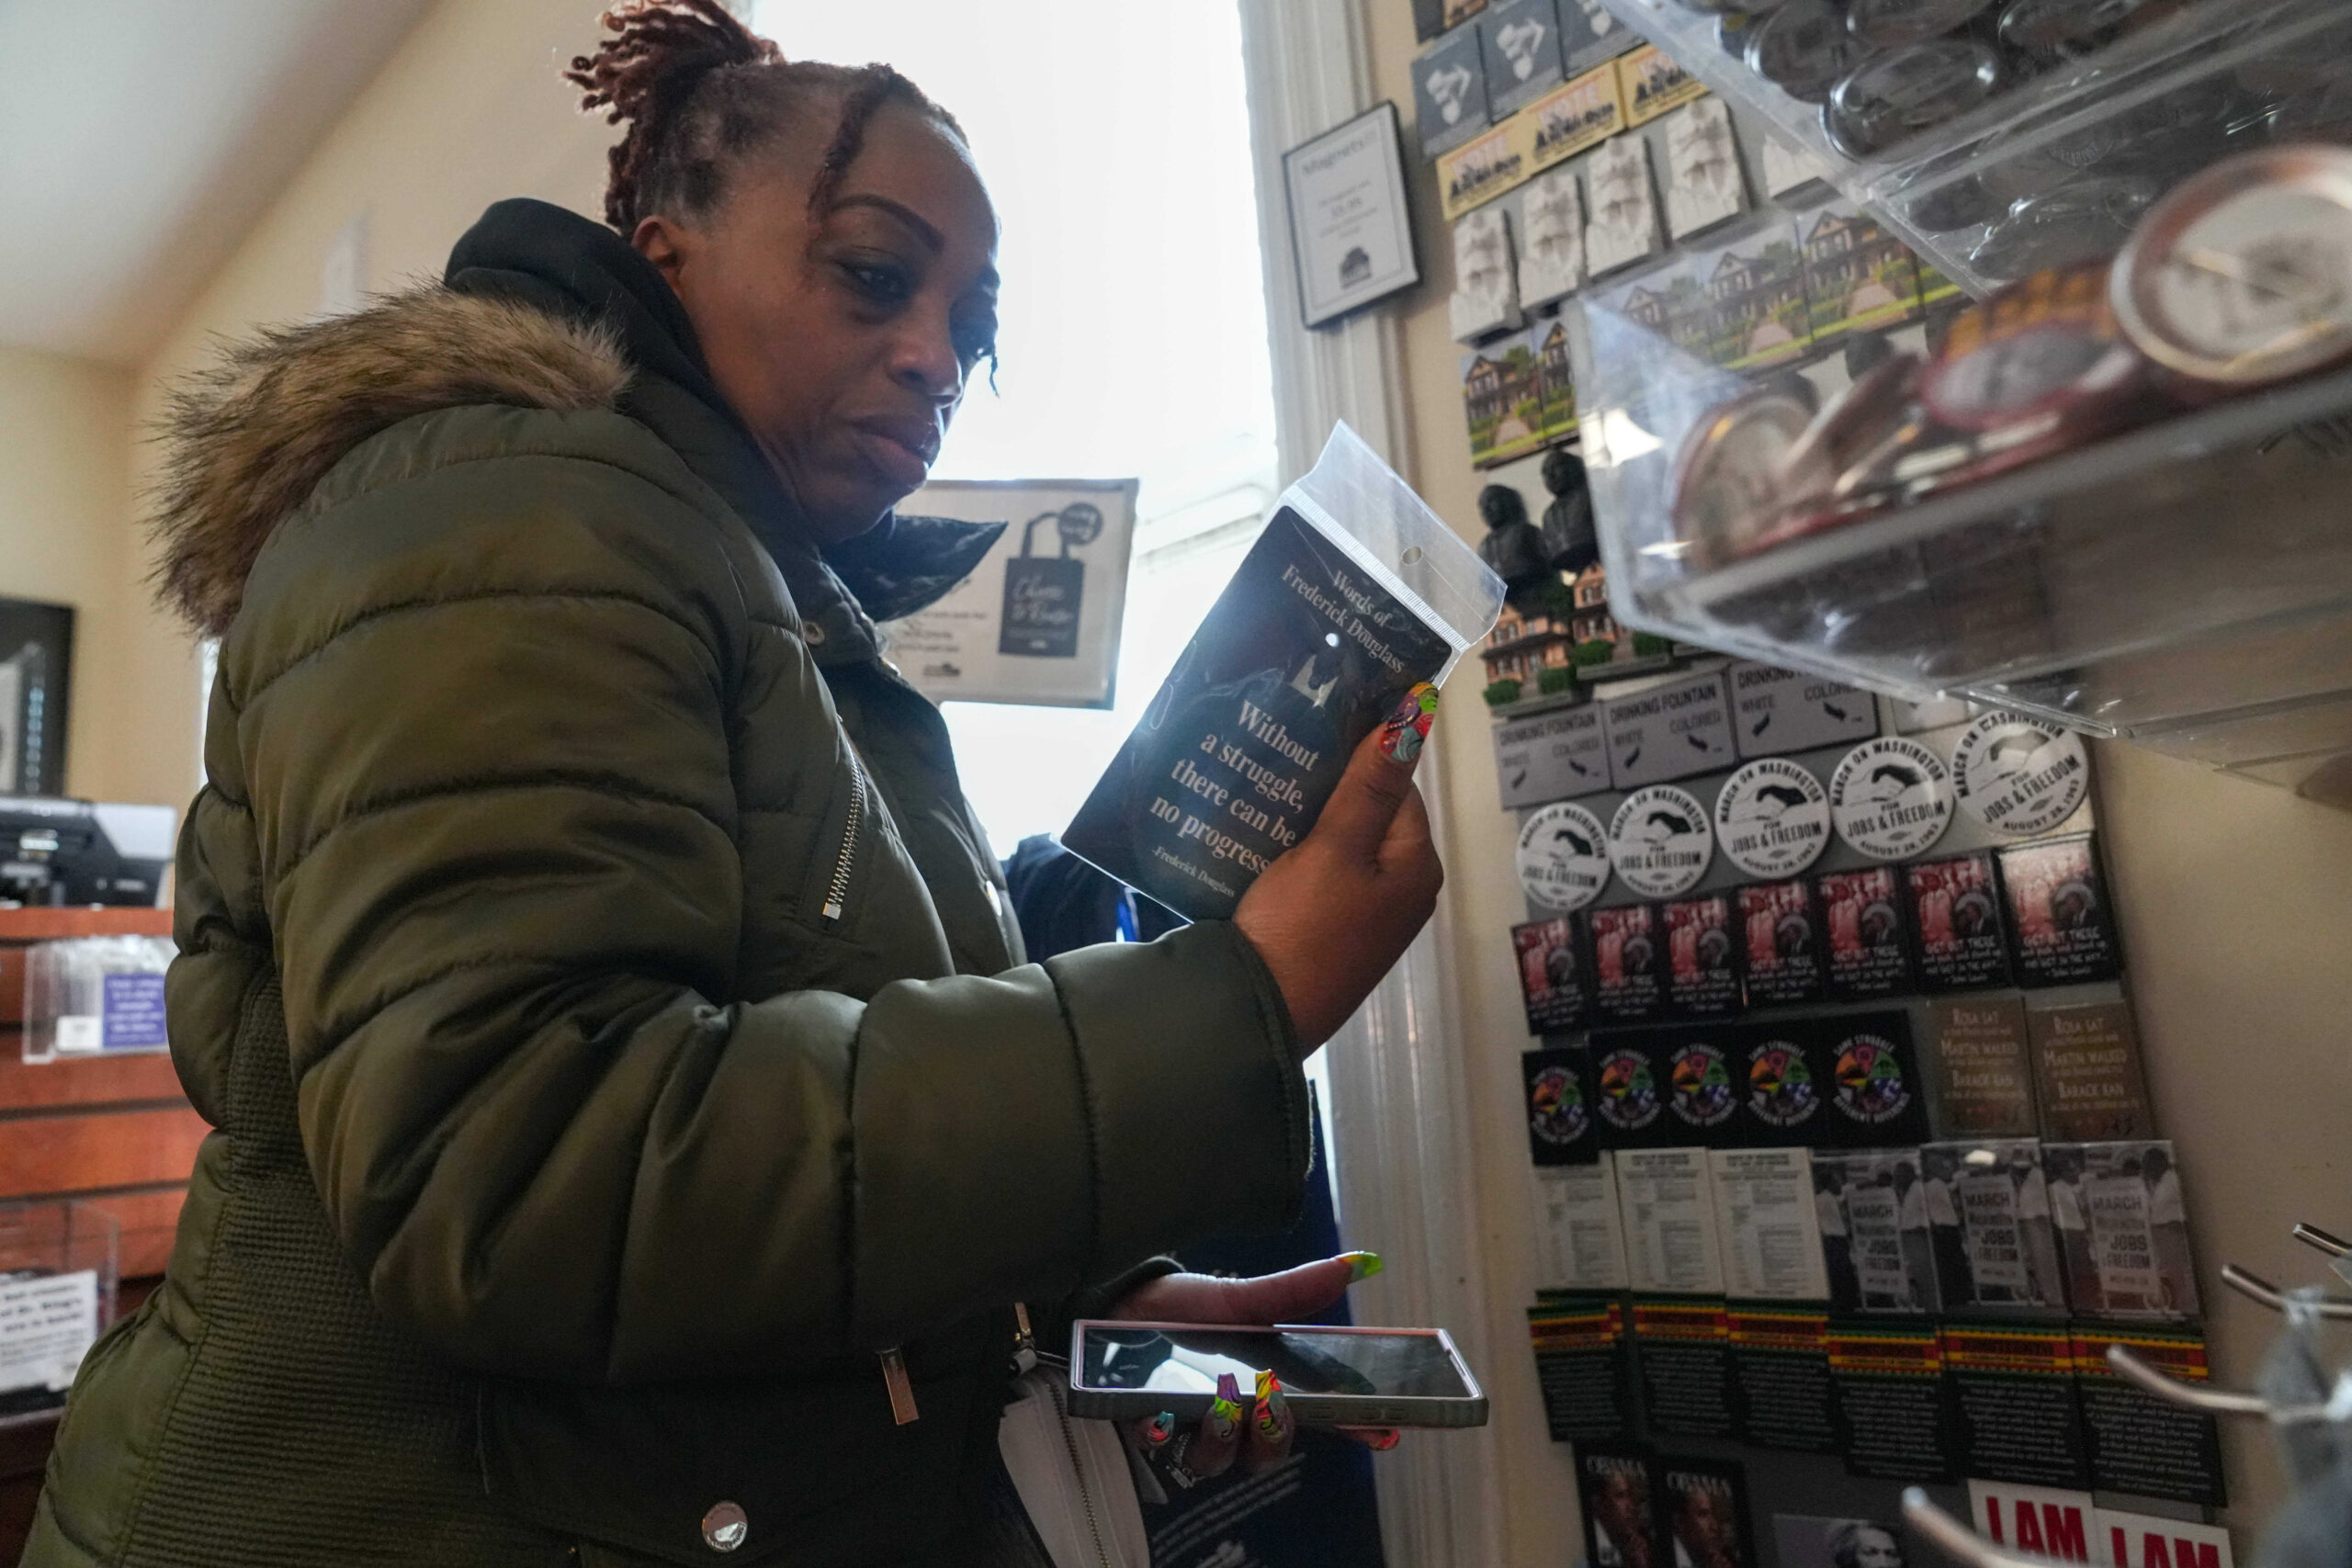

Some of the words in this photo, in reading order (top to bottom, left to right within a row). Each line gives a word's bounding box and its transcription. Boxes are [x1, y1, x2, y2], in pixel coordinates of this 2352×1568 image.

[1333, 570, 1375, 615] Words
[1374, 612, 1393, 627] of
[1281, 563, 1349, 627] Frederick
[1347, 617, 1406, 674] Douglass
[1610, 698, 1660, 725] DRINKING
[1661, 684, 1716, 709] FOUNTAIN
[1741, 694, 1775, 713] WHITE
[1238, 699, 1319, 772] Without
[1499, 722, 1545, 747] DRINKING
[1546, 712, 1596, 735] FOUNTAIN
[1613, 728, 1644, 746] WHITE
[1668, 708, 1721, 734] COLORED
[1552, 736, 1600, 759] COLORED
[1200, 734, 1218, 754] a
[1217, 742, 1305, 815] struggle,
[1832, 763, 1853, 807] MARCH
[1851, 750, 1869, 766] ON
[1871, 740, 1945, 783] WASHINGTON
[1952, 751, 1971, 799] MARCH
[1962, 730, 1979, 749] ON
[1983, 795, 2014, 824] JOBS
[2012, 789, 2026, 806] &
[2022, 754, 2081, 797] FREEDOM
[2010, 771, 2030, 786] FOR
[1170, 758, 1228, 807] there
[1229, 798, 1269, 832] can
[1269, 816, 1296, 847] be
[1720, 780, 1740, 824] MARCH
[1738, 770, 1755, 784] ON
[1758, 761, 1824, 804] WASHINGTON
[1149, 795, 1181, 824] no
[1611, 803, 1634, 840] MARCH
[1634, 794, 1648, 806] ON
[1654, 787, 1706, 834] WASHINGTON
[1880, 801, 1901, 812] FOR
[1762, 820, 1781, 830] FOR
[1846, 819, 1875, 839] JOBS
[1878, 817, 1887, 831] &
[1889, 800, 1947, 828] FREEDOM
[2002, 815, 2048, 830] AUGUST
[1730, 835, 1758, 854] JOBS
[1759, 831, 1769, 847] &
[1770, 820, 1822, 845] FREEDOM
[1860, 840, 1901, 855] AUGUST
[1619, 854, 1642, 870] JOBS
[1645, 853, 1653, 869] &
[1655, 852, 1702, 868] FREEDOM
[1743, 856, 1780, 872] AUGUST
[1197, 869, 1235, 898] Douglass
[1522, 864, 1544, 880] JOBS
[1555, 870, 1598, 888] FREEDOM
[1925, 942, 1945, 955] GET
[1948, 939, 1964, 952] OUT
[1967, 935, 1996, 949] THERE
[2023, 931, 2044, 947] GET
[2047, 930, 2065, 944] OUT
[2070, 926, 2100, 942] THERE
[1873, 944, 1899, 957] THERE
[1854, 1033, 1895, 1054] STRUGGLE
[1852, 1204, 1894, 1219] MARCH
[1966, 1193, 2010, 1208] MARCH
[2093, 1196, 2143, 1210] MARCH
[1867, 1241, 1899, 1255] JOBS
[1981, 1230, 2017, 1246] JOBS
[2110, 1235, 2148, 1251] JOBS
[1586, 1455, 1647, 1481] OBAMA
[1667, 1471, 1733, 1496] OBAMA
[1986, 1495, 2005, 1547] I
[2016, 1499, 2088, 1563] AM
[2110, 1527, 2129, 1568] I
[2143, 1532, 2220, 1568] AM
